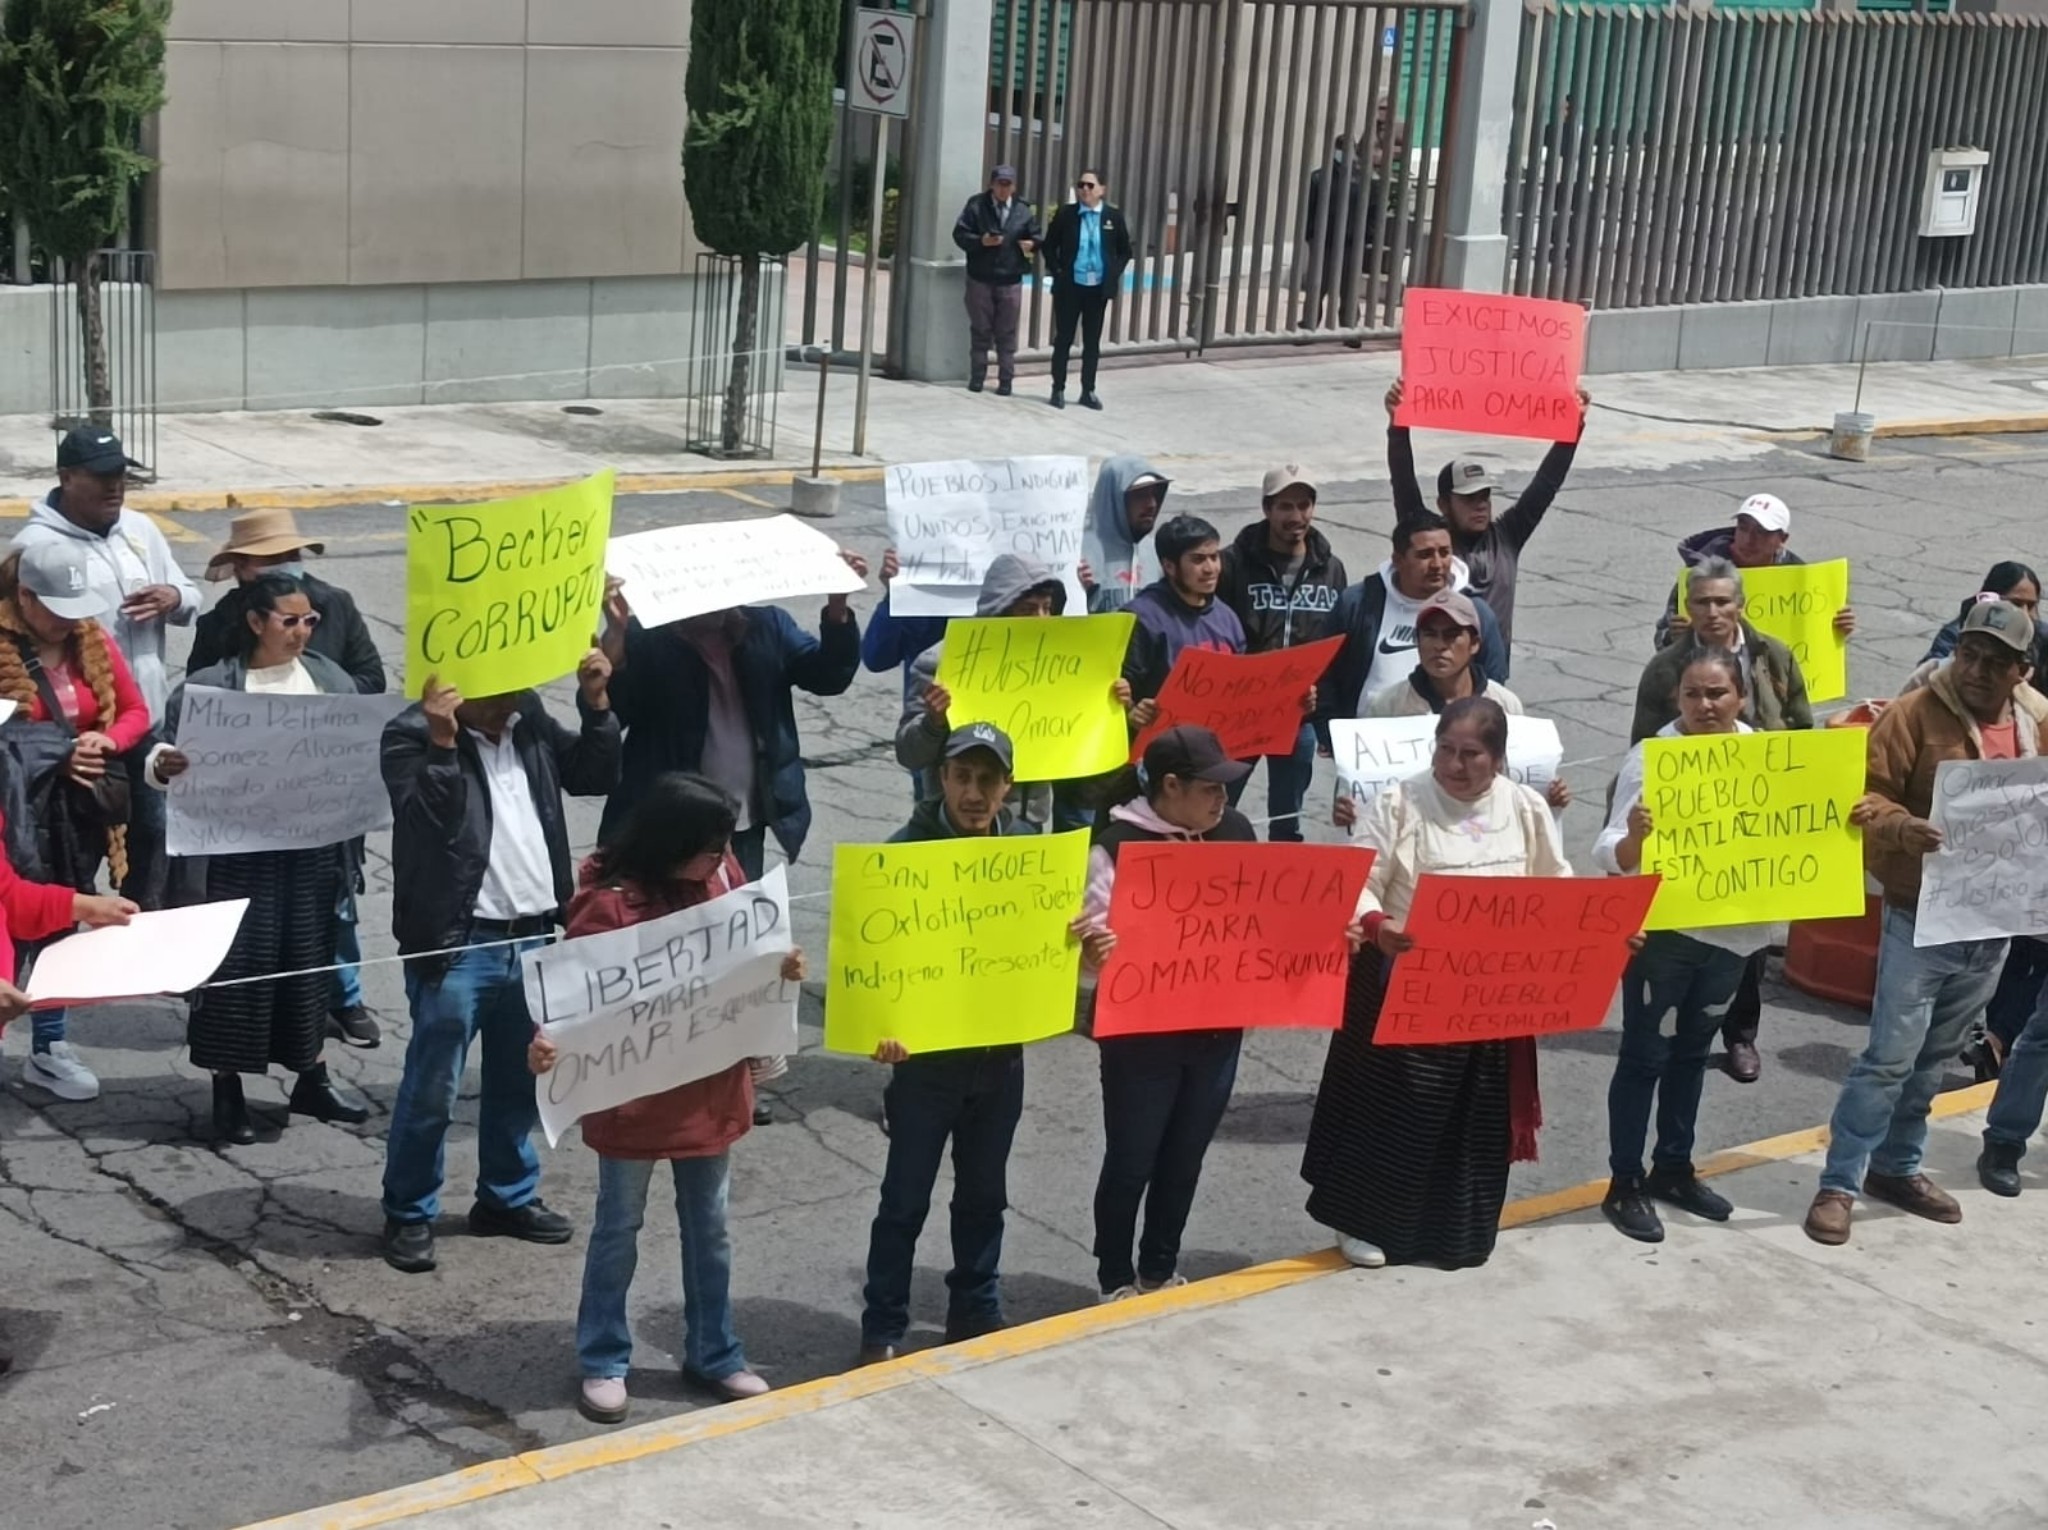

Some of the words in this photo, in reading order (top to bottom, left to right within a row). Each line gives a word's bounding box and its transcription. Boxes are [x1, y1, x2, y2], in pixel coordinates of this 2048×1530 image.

[1423, 300, 1572, 340] EXIGIMOS
[1417, 346, 1567, 383] JUSTICIA
[1411, 385, 1464, 413] PARA
[1485, 391, 1567, 420] OMAR
[894, 466, 998, 499] PUEBLOS
[187, 696, 250, 728] Mtra
[267, 699, 359, 730] Delfina
[1006, 700, 1083, 744] Omar
[1657, 738, 1745, 782] OMAR
[1765, 736, 1806, 772] EL
[1656, 774, 1769, 819] PUEBLO
[1942, 766, 2016, 797] Omar
[861, 852, 929, 890] SAN
[954, 849, 1055, 884] MIGUEL
[1653, 855, 1705, 881] ESTA
[1697, 854, 1818, 902] CONTIGO
[1436, 888, 1545, 929] OMAR
[1578, 894, 1626, 934] ES
[1174, 914, 1262, 950] PARA
[535, 897, 780, 1024] LIBERTAD
[1109, 957, 1221, 1004] OMAR
[1235, 948, 1347, 982] ESQUIVEL
[1403, 945, 1598, 977] INOCENTE
[613, 976, 709, 1025] PARA
[1402, 980, 1438, 1005] EL
[1462, 981, 1578, 1007] PUEBLO
[1390, 1012, 1422, 1033] TE
[1446, 1011, 1570, 1034] RESPALDA
[549, 1021, 673, 1105] OMAR
